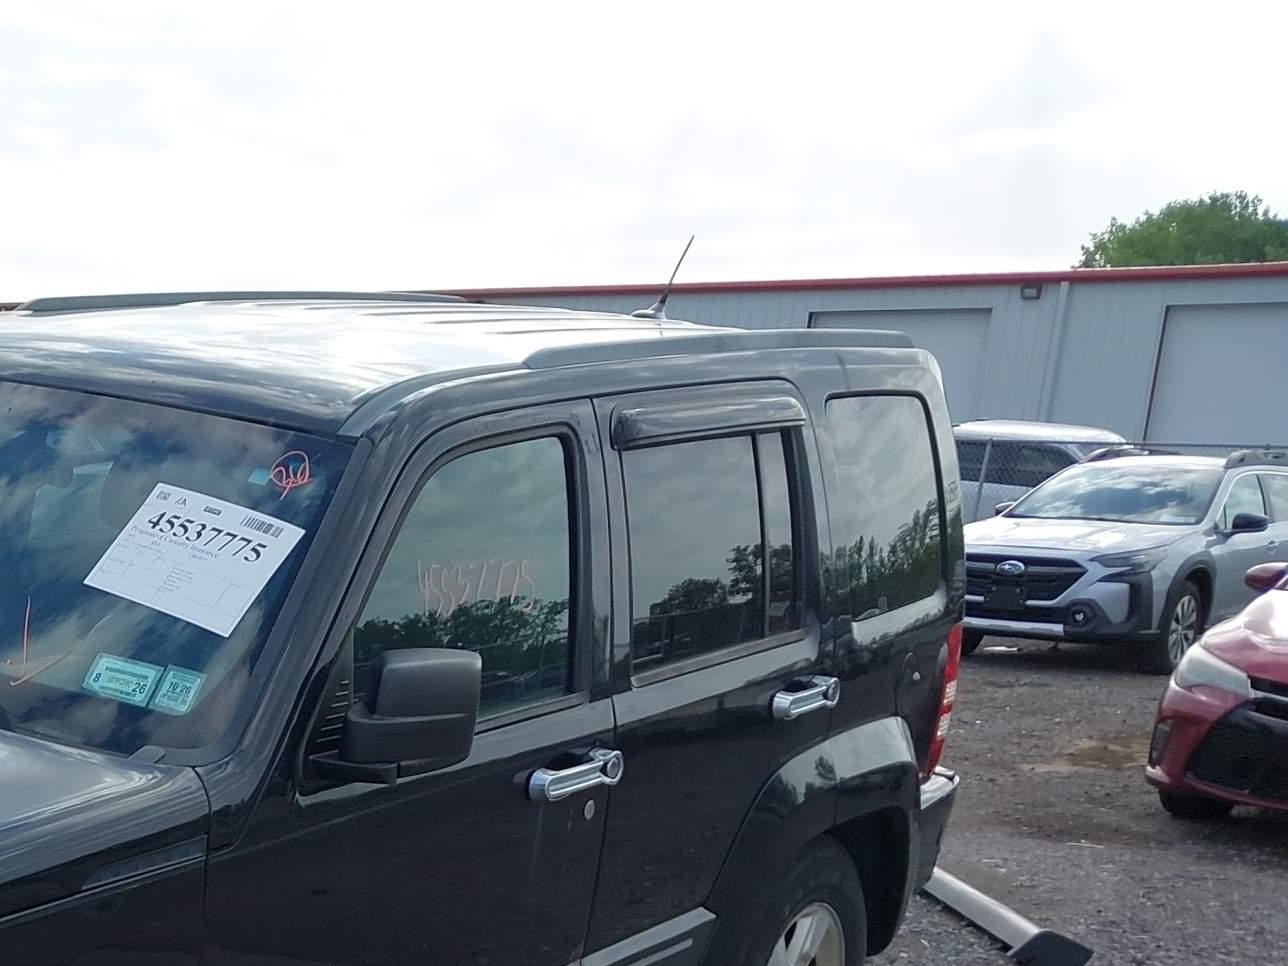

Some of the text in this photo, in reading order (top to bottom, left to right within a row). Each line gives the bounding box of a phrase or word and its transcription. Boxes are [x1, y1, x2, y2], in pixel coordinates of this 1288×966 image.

[147, 511, 267, 563] 45537775
[93, 672, 102, 683] 8
[132, 682, 147, 695] 26
